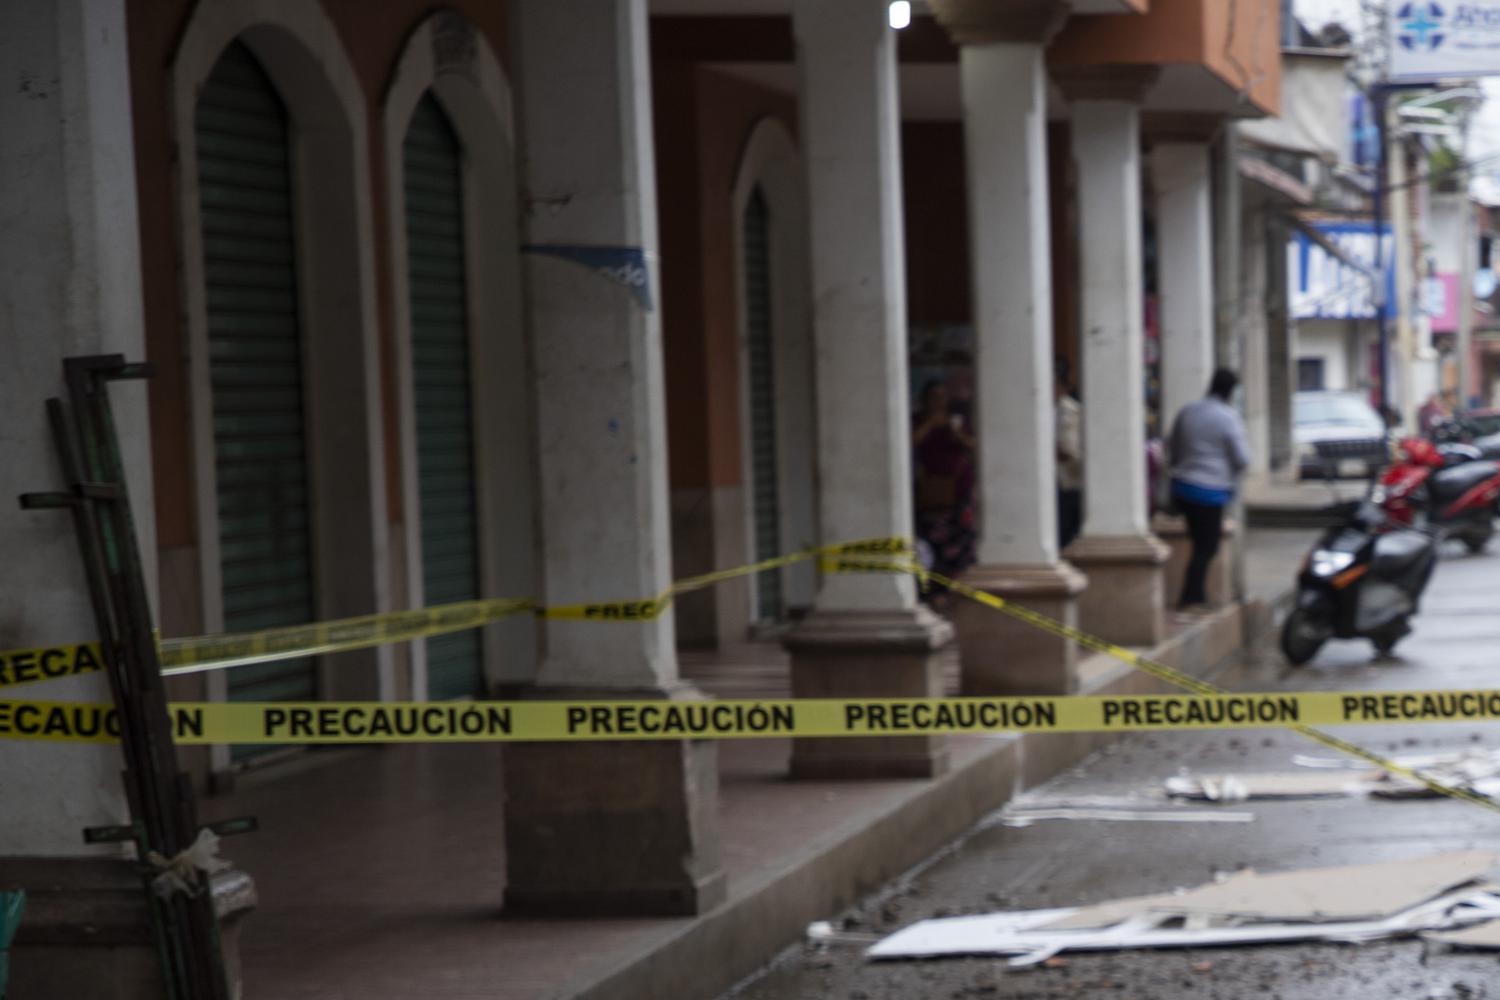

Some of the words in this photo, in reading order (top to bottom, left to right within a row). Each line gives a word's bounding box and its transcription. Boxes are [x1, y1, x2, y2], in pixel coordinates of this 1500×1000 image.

[264, 704, 512, 737] PRECAUCIÓN
[567, 703, 795, 731] PRECAUCIÓN
[845, 700, 1056, 730] PRECAUCIÓN
[1102, 691, 1299, 723] PRECAUCIÓN
